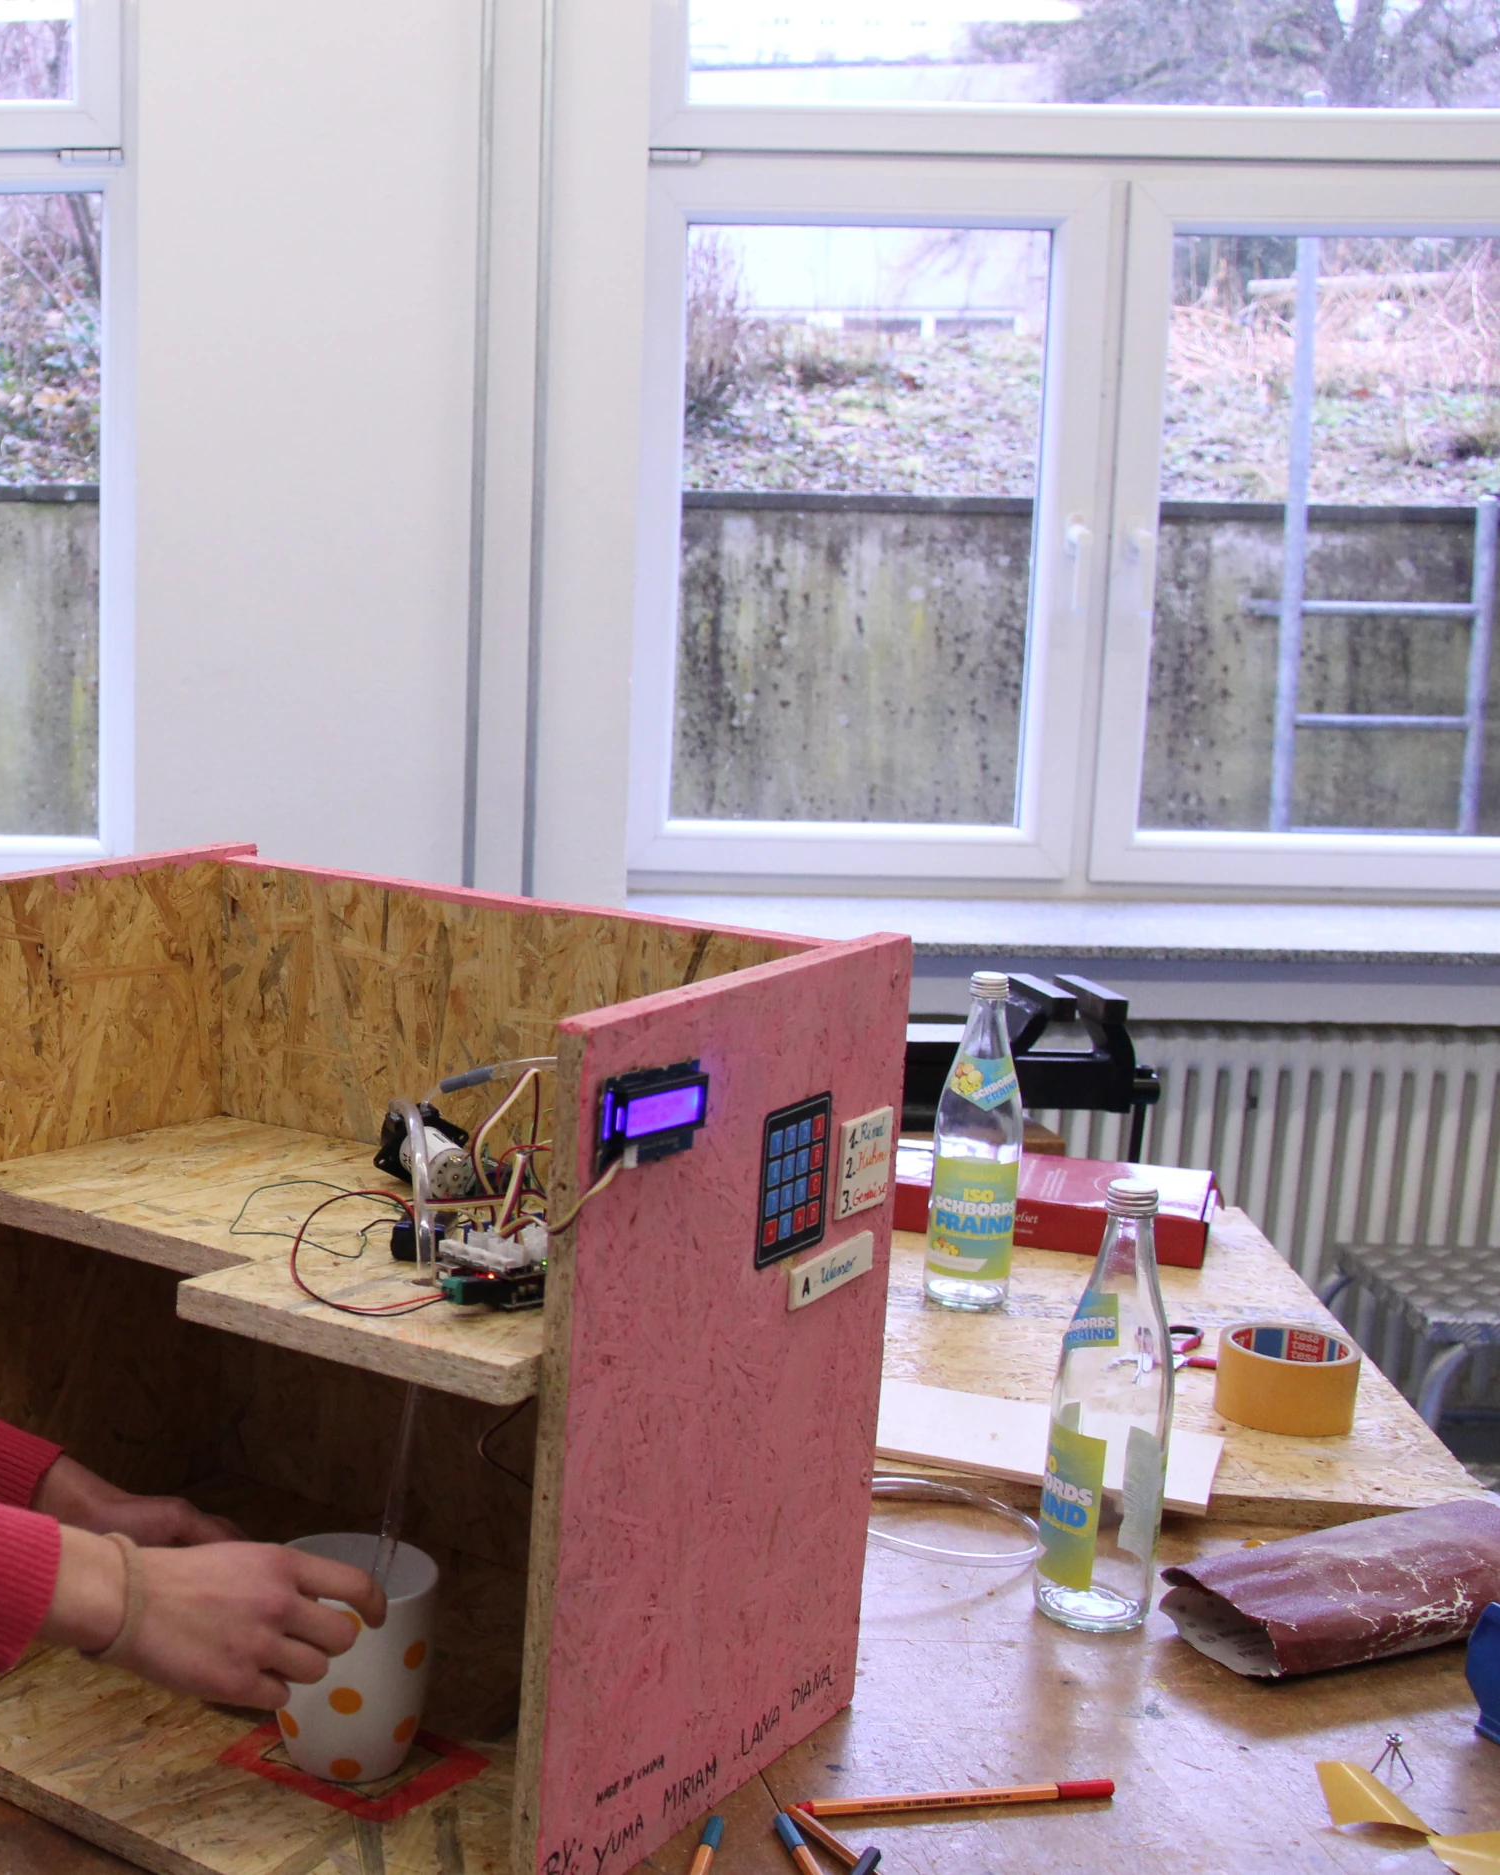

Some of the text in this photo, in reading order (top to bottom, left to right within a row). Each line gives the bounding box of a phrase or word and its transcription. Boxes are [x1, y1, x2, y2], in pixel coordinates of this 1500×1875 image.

[935, 1194, 1016, 1216] SCHBORDS
[963, 1187, 996, 1203] ISO
[936, 1209, 1013, 1234] FRAIND
[1015, 1210, 1039, 1224] elset
[801, 1276, 810, 1298] A
[1292, 1340, 1320, 1354] tesa
[1293, 1330, 1320, 1344] tesa
[1291, 1350, 1318, 1362] tesa
[1043, 1471, 1093, 1507] ORDS
[593, 1813, 644, 1875] YUMA
[662, 1755, 717, 1818] MIRIAM
[740, 1706, 780, 1756] LANA
[791, 1664, 833, 1712] DIANA
[623, 1769, 635, 1790] IN
